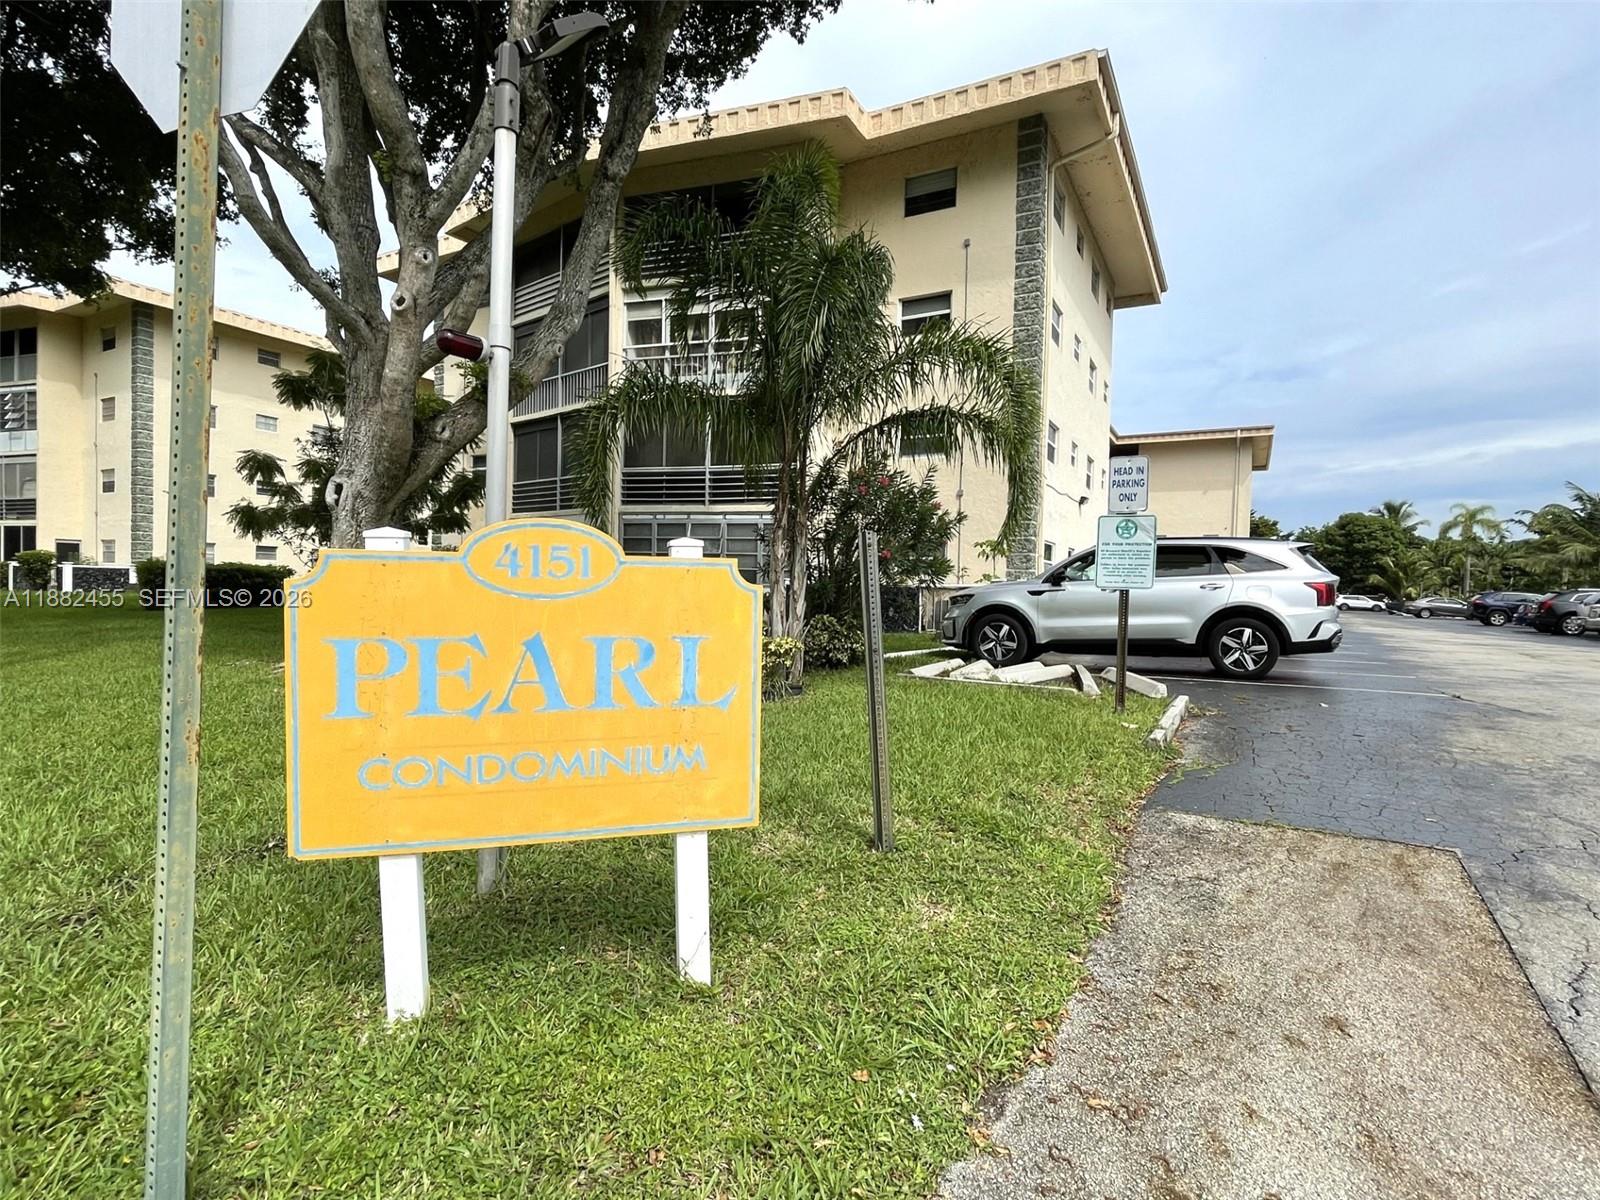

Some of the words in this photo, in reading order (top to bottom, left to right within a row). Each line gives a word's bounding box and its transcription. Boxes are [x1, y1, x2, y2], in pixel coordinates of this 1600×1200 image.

[1112, 478, 1145, 488] PARKING
[1113, 467, 1134, 476] HEAD
[1136, 466, 1145, 476] IN
[1118, 493, 1138, 502] ONLY
[494, 542, 592, 580] 4151
[321, 631, 738, 720] PEARL
[357, 743, 708, 792] CONDOMINIUM
